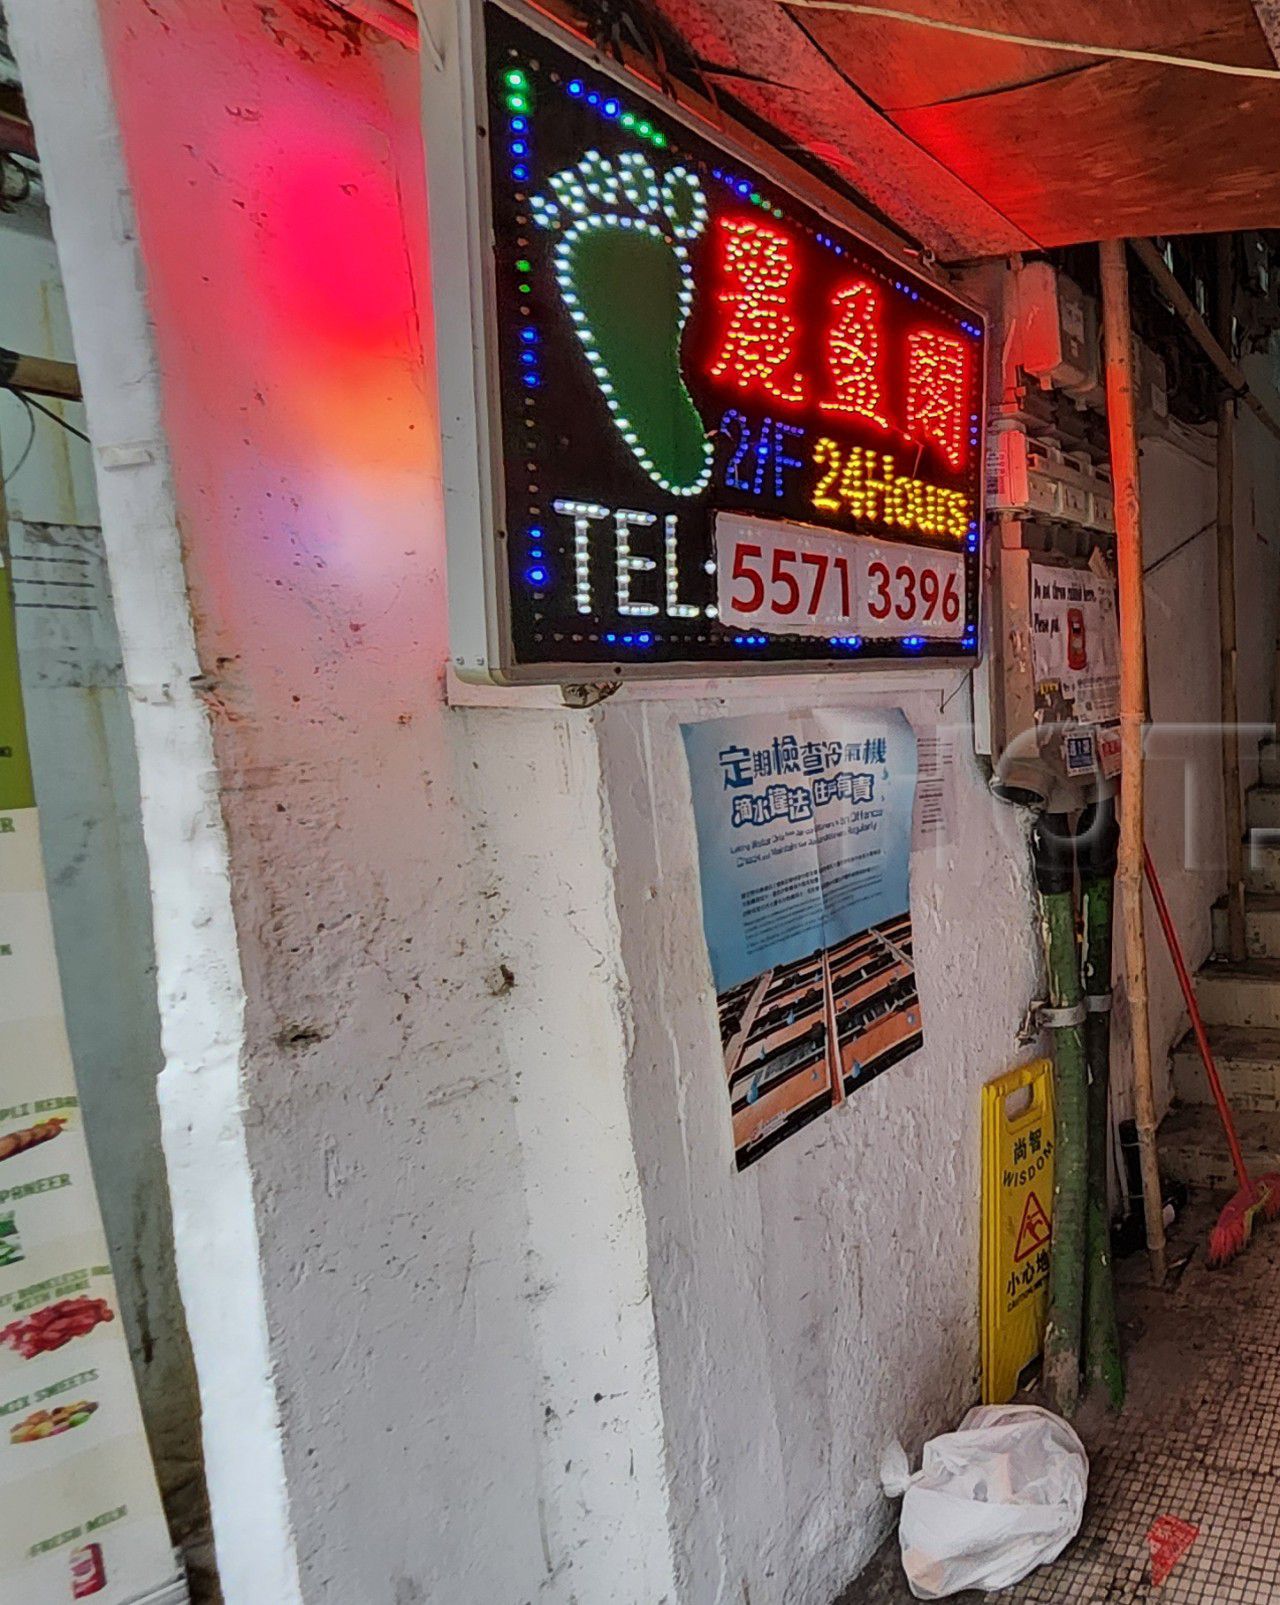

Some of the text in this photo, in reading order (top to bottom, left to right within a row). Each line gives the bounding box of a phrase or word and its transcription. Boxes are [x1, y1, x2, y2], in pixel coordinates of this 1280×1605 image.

[731, 542, 960, 622] 5571 3396
[718, 734, 888, 791] 定期檢查冷氣機
[1003, 1140, 1054, 1188] WISDOM
